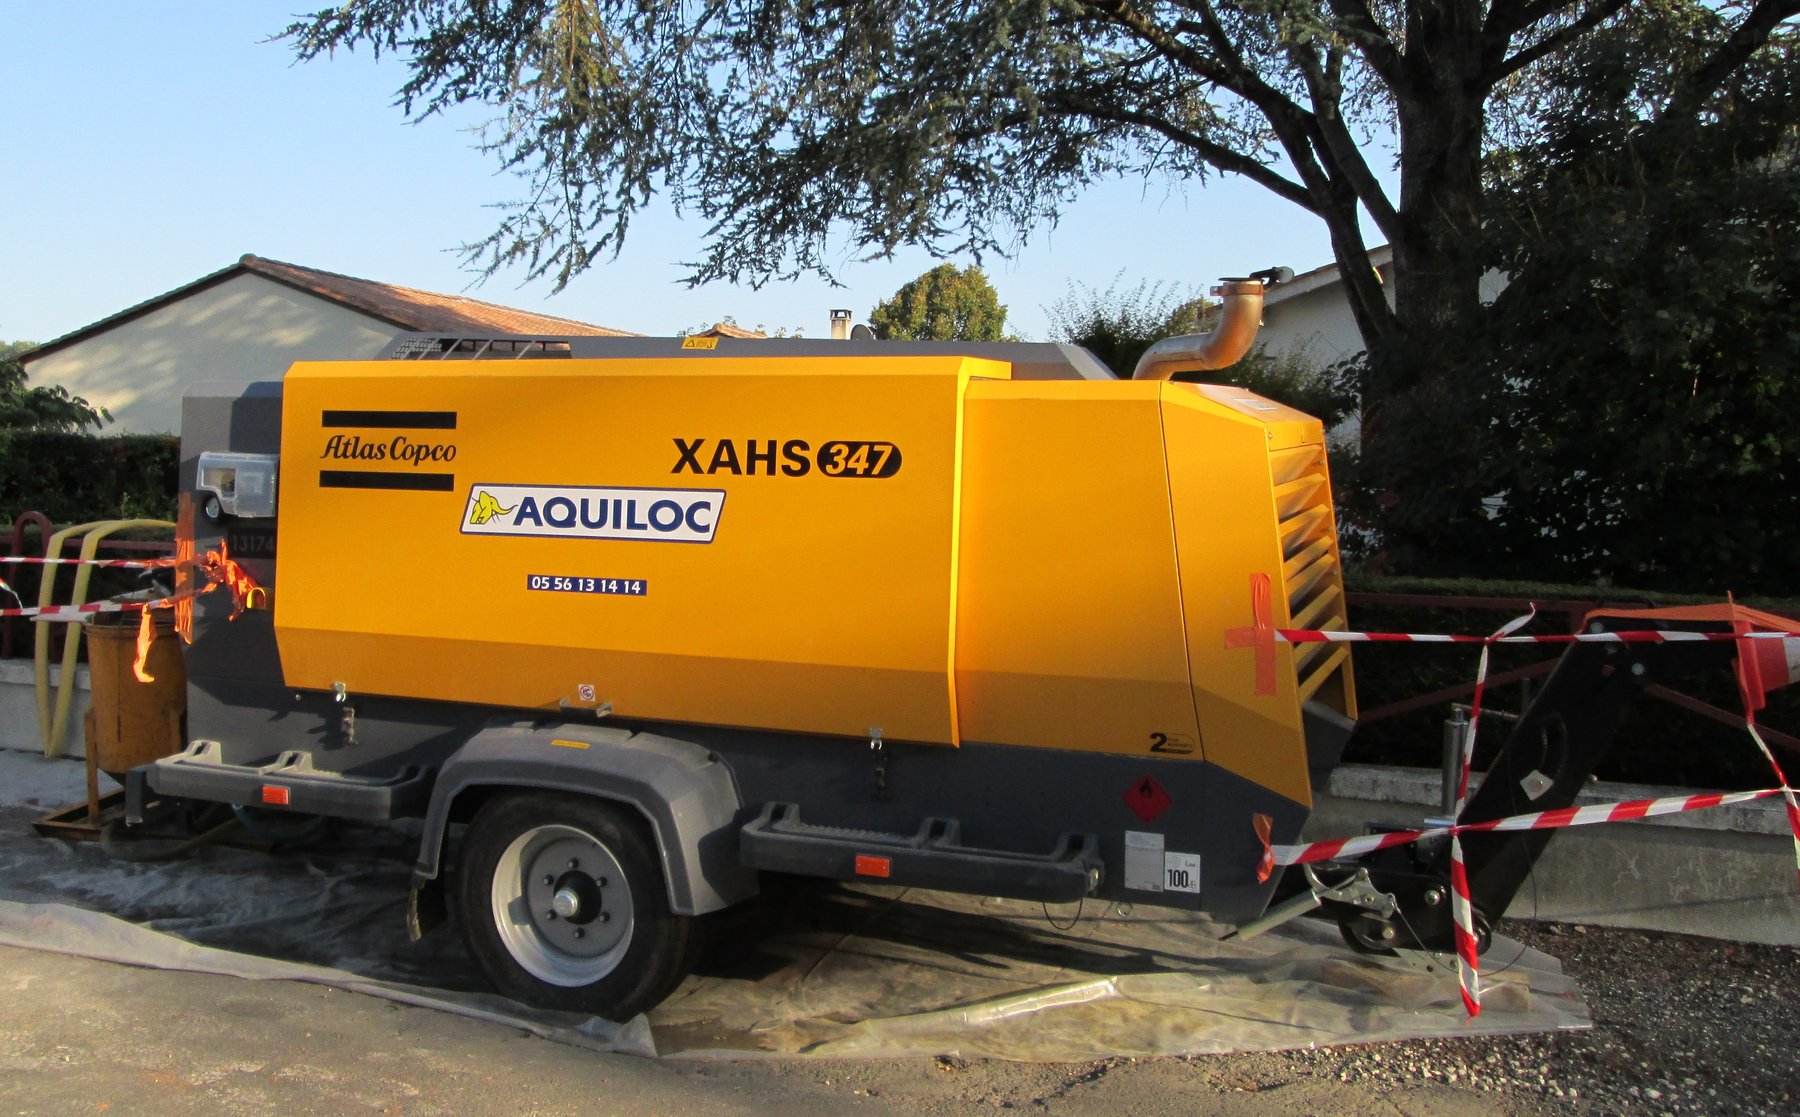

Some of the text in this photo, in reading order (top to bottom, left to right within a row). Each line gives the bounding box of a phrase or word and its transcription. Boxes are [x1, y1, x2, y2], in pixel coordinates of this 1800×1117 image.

[320, 434, 457, 467] Atlas Copco
[670, 438, 893, 477] XAHS 347
[512, 496, 712, 534] AQUILOC
[531, 576, 641, 594] 05 56 13 14 14
[1149, 732, 1167, 752] 2
[1167, 869, 1189, 888] 100
